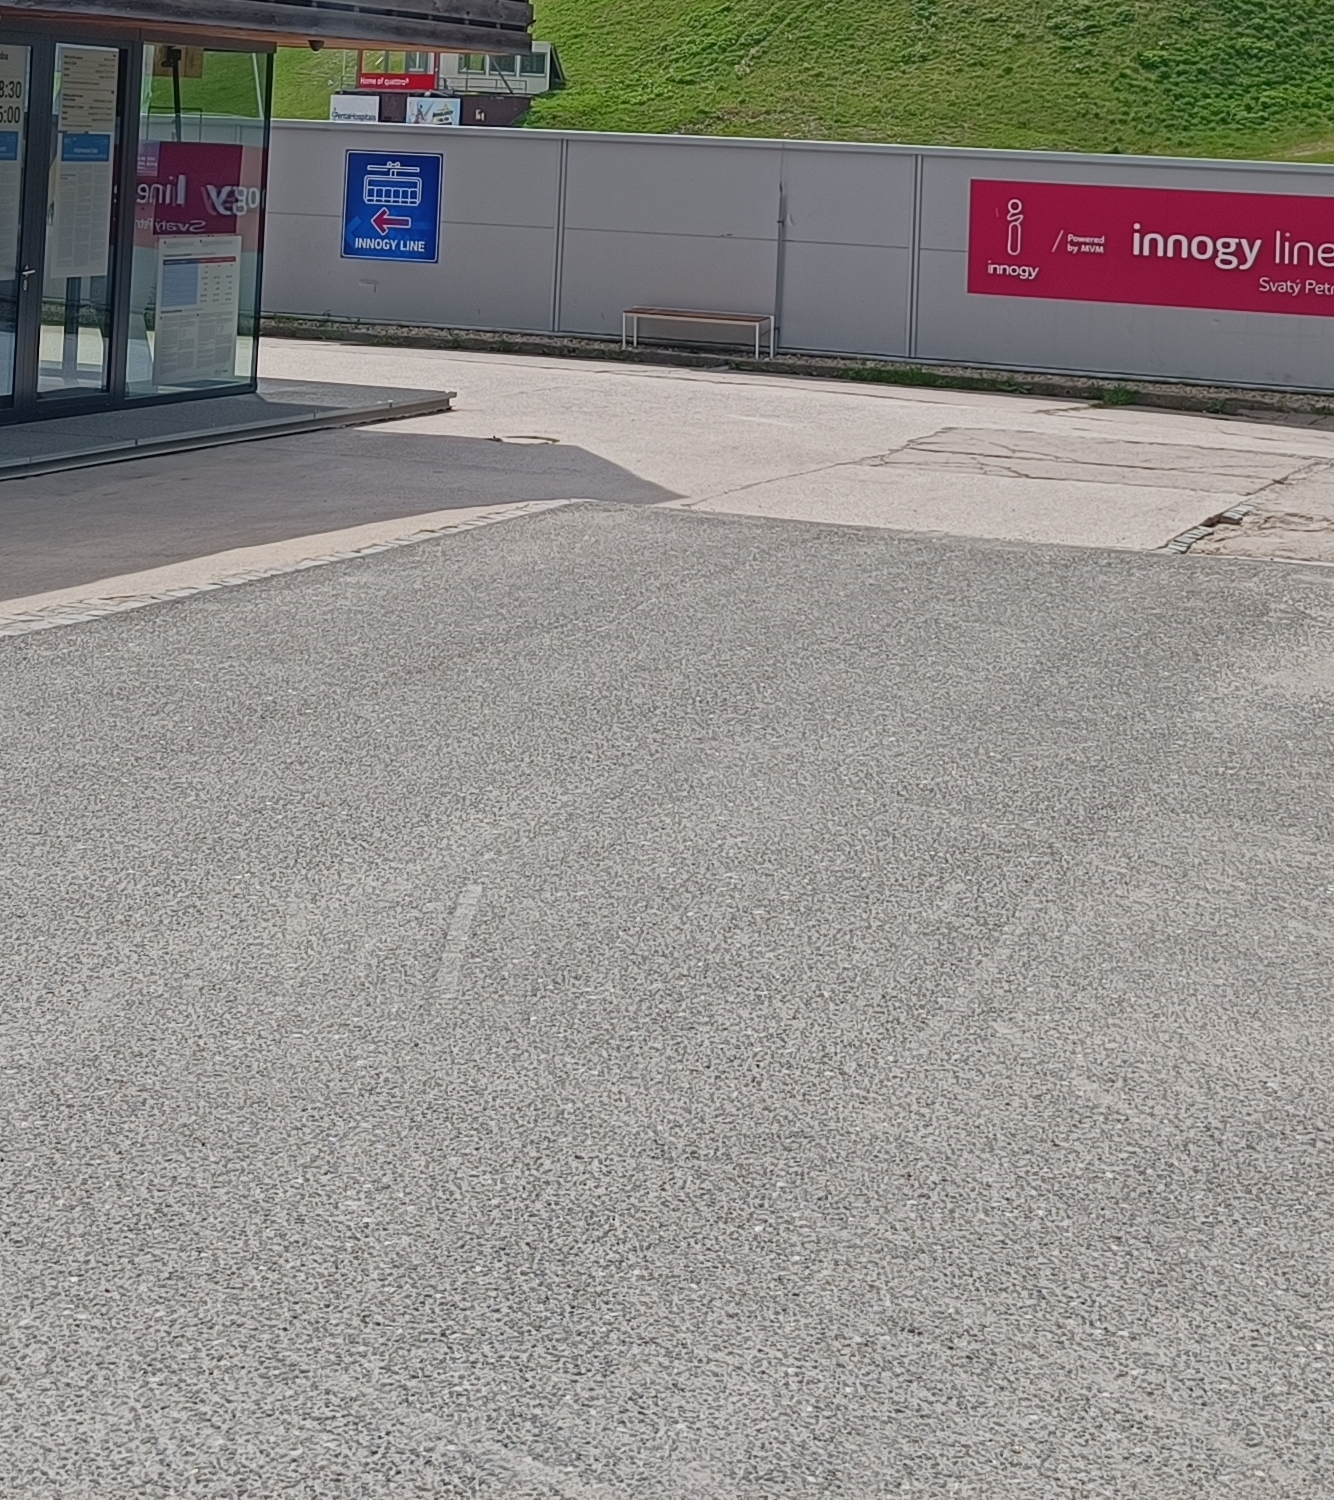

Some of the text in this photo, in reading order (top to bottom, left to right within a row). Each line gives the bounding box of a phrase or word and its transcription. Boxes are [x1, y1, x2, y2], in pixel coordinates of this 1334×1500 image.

[355, 237, 425, 252] INNOGY LINE
[1067, 233, 1105, 244] Powered
[1133, 222, 1262, 270] innogy
[1067, 244, 1105, 254] by MVM
[987, 260, 1039, 280] innogy
[1259, 277, 1301, 296] Svatý
